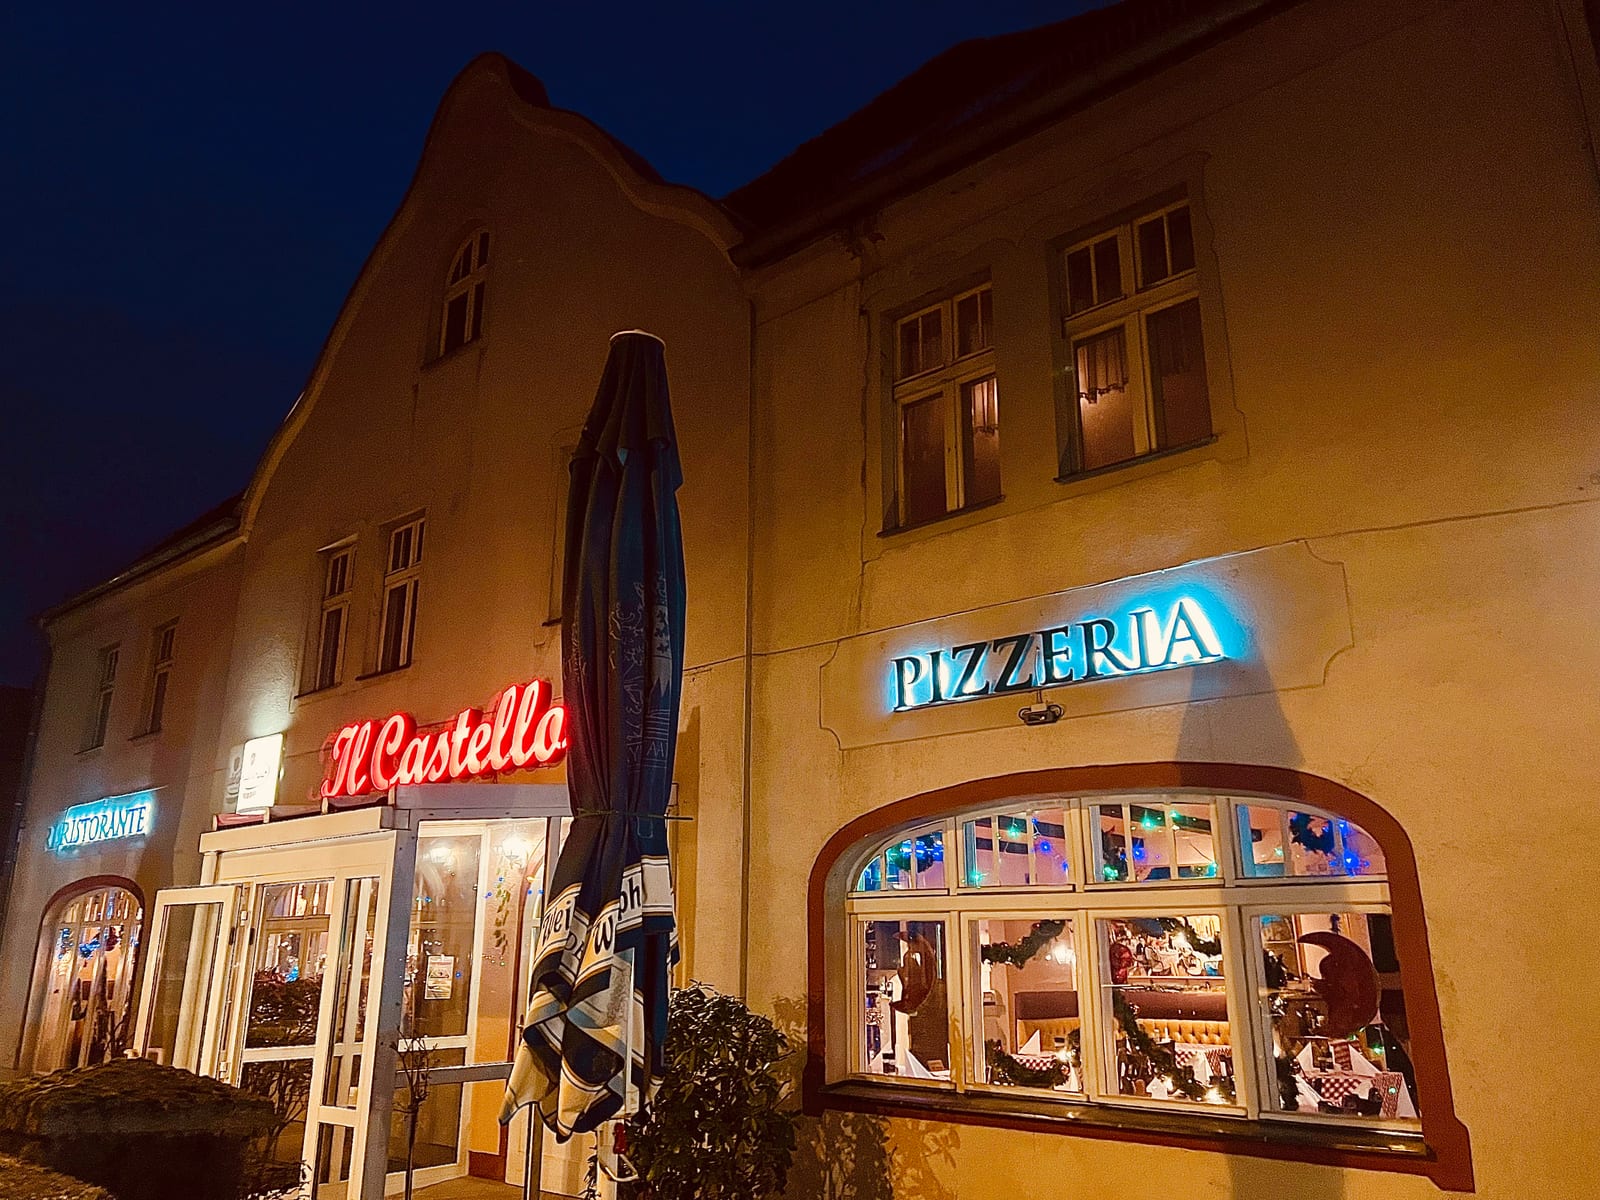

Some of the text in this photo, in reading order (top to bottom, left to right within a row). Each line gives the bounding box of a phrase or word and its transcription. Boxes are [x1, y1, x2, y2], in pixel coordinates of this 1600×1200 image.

[890, 601, 1222, 711] PIZZERIA
[321, 679, 568, 797] Il Castello
[56, 806, 147, 847] RISTORANTE
